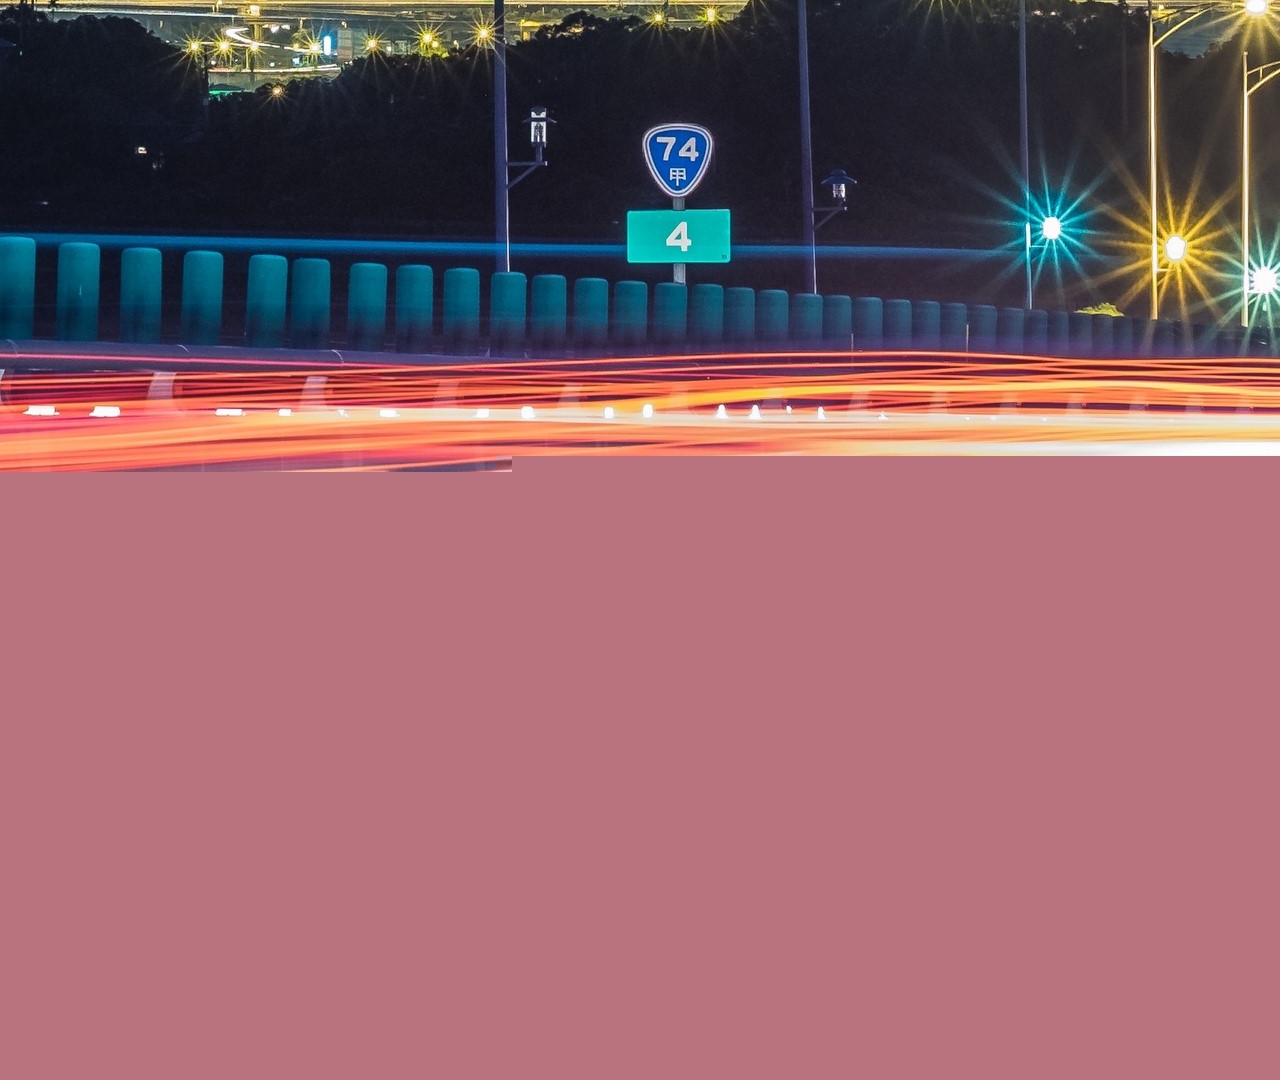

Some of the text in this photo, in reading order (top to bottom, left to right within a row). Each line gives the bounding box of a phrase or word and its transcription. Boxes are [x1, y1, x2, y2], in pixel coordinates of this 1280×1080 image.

[656, 137, 699, 161] 74
[669, 168, 686, 186] 甲
[665, 221, 692, 252] 4
